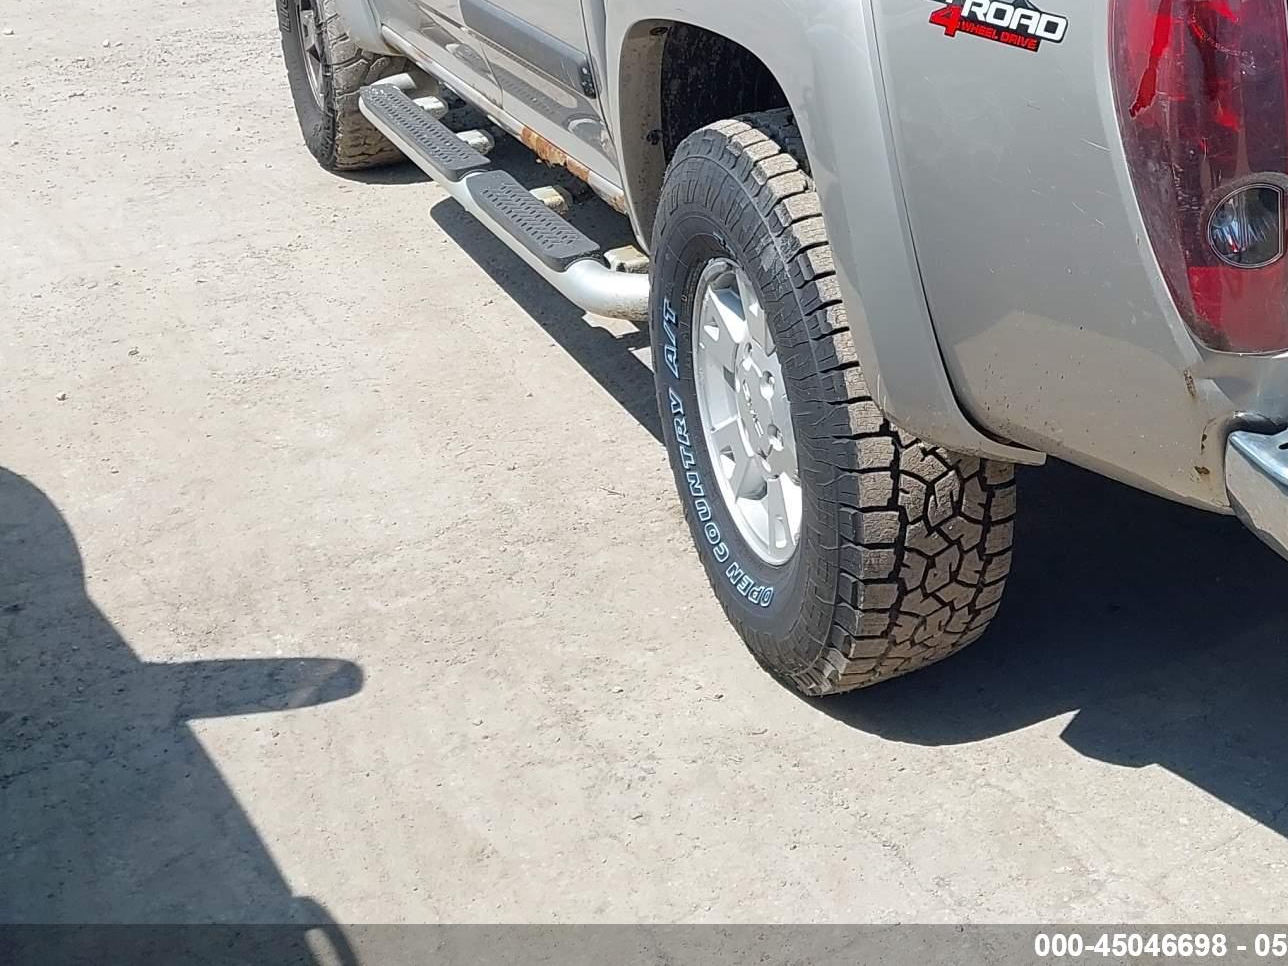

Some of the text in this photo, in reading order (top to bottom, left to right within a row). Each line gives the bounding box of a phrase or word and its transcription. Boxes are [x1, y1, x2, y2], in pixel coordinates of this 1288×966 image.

[929, 5, 1039, 50] 4 WHEEL DRIVE
[663, 297, 774, 607] OPEN COUNTRY A/T
